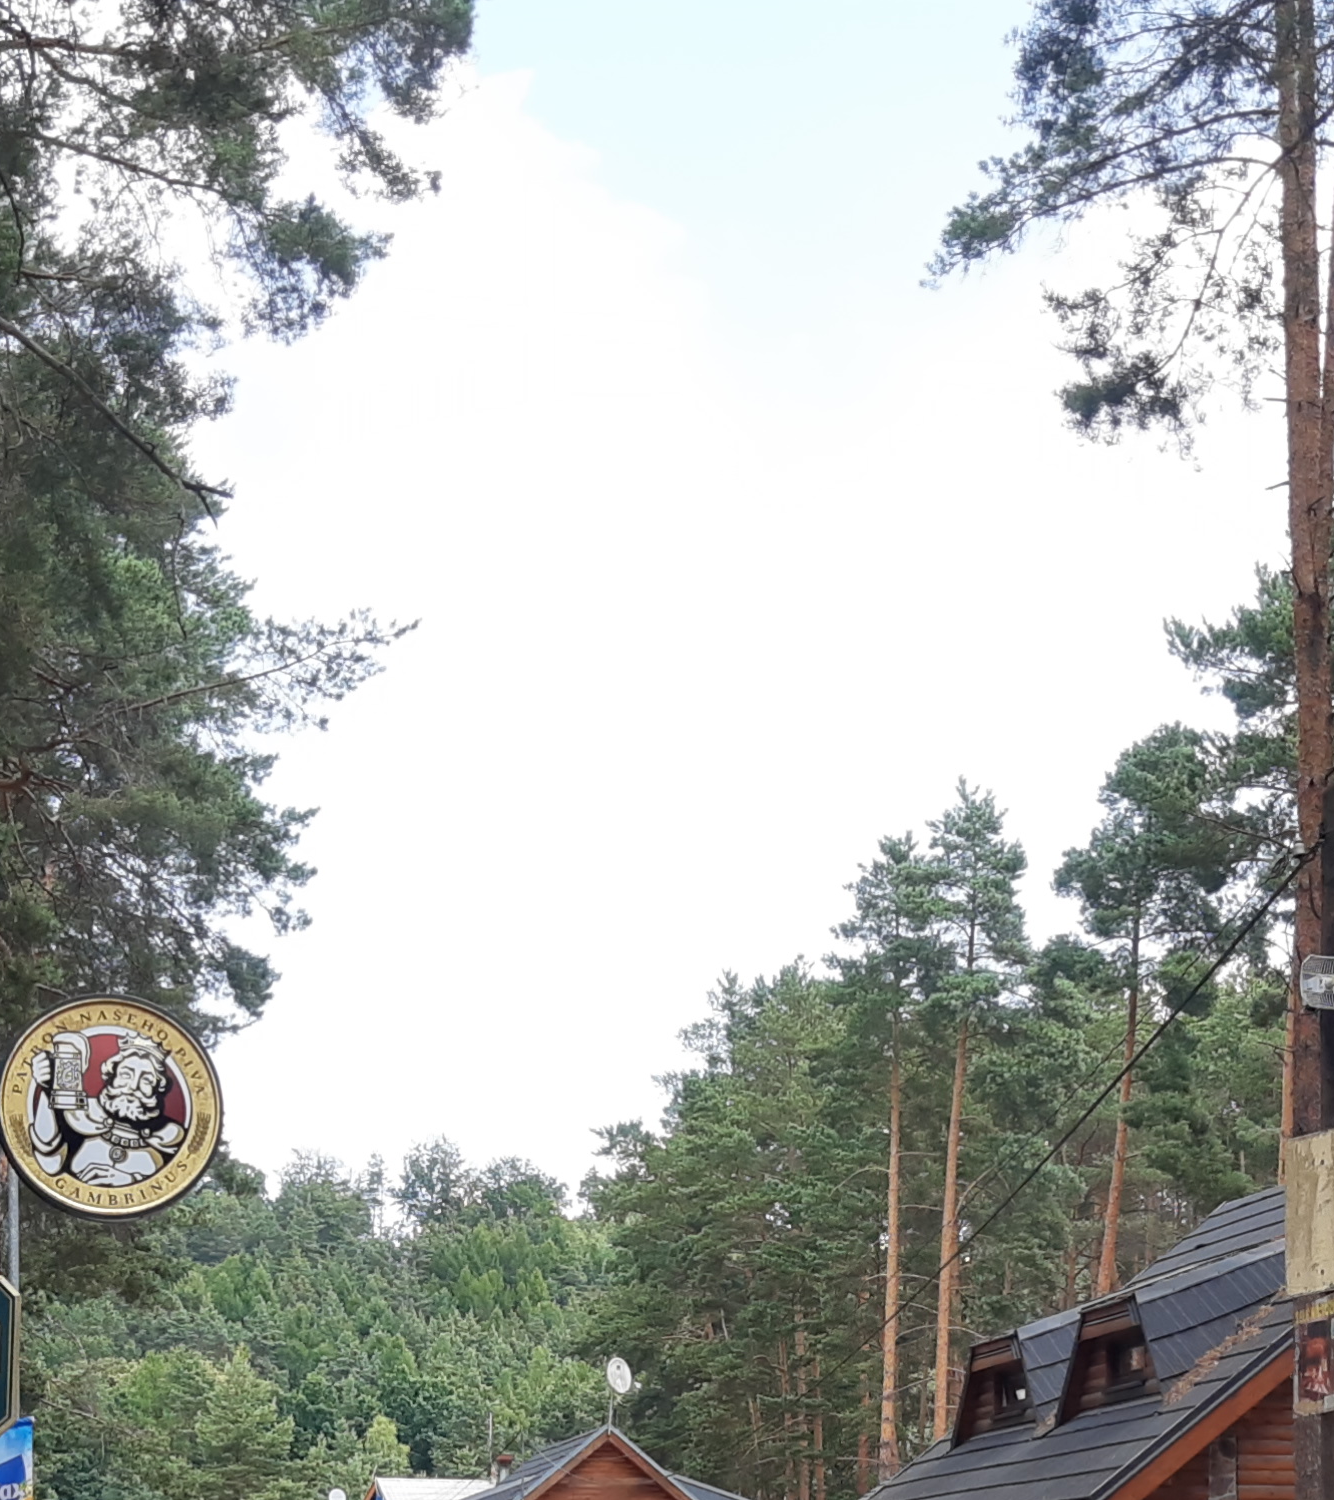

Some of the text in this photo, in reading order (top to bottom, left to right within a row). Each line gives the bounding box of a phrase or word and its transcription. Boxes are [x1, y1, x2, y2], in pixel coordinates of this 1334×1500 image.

[12, 1022, 67, 1094] PATRON
[176, 1047, 205, 1096] PIVA
[55, 1162, 187, 1205] GAMBRINUS
